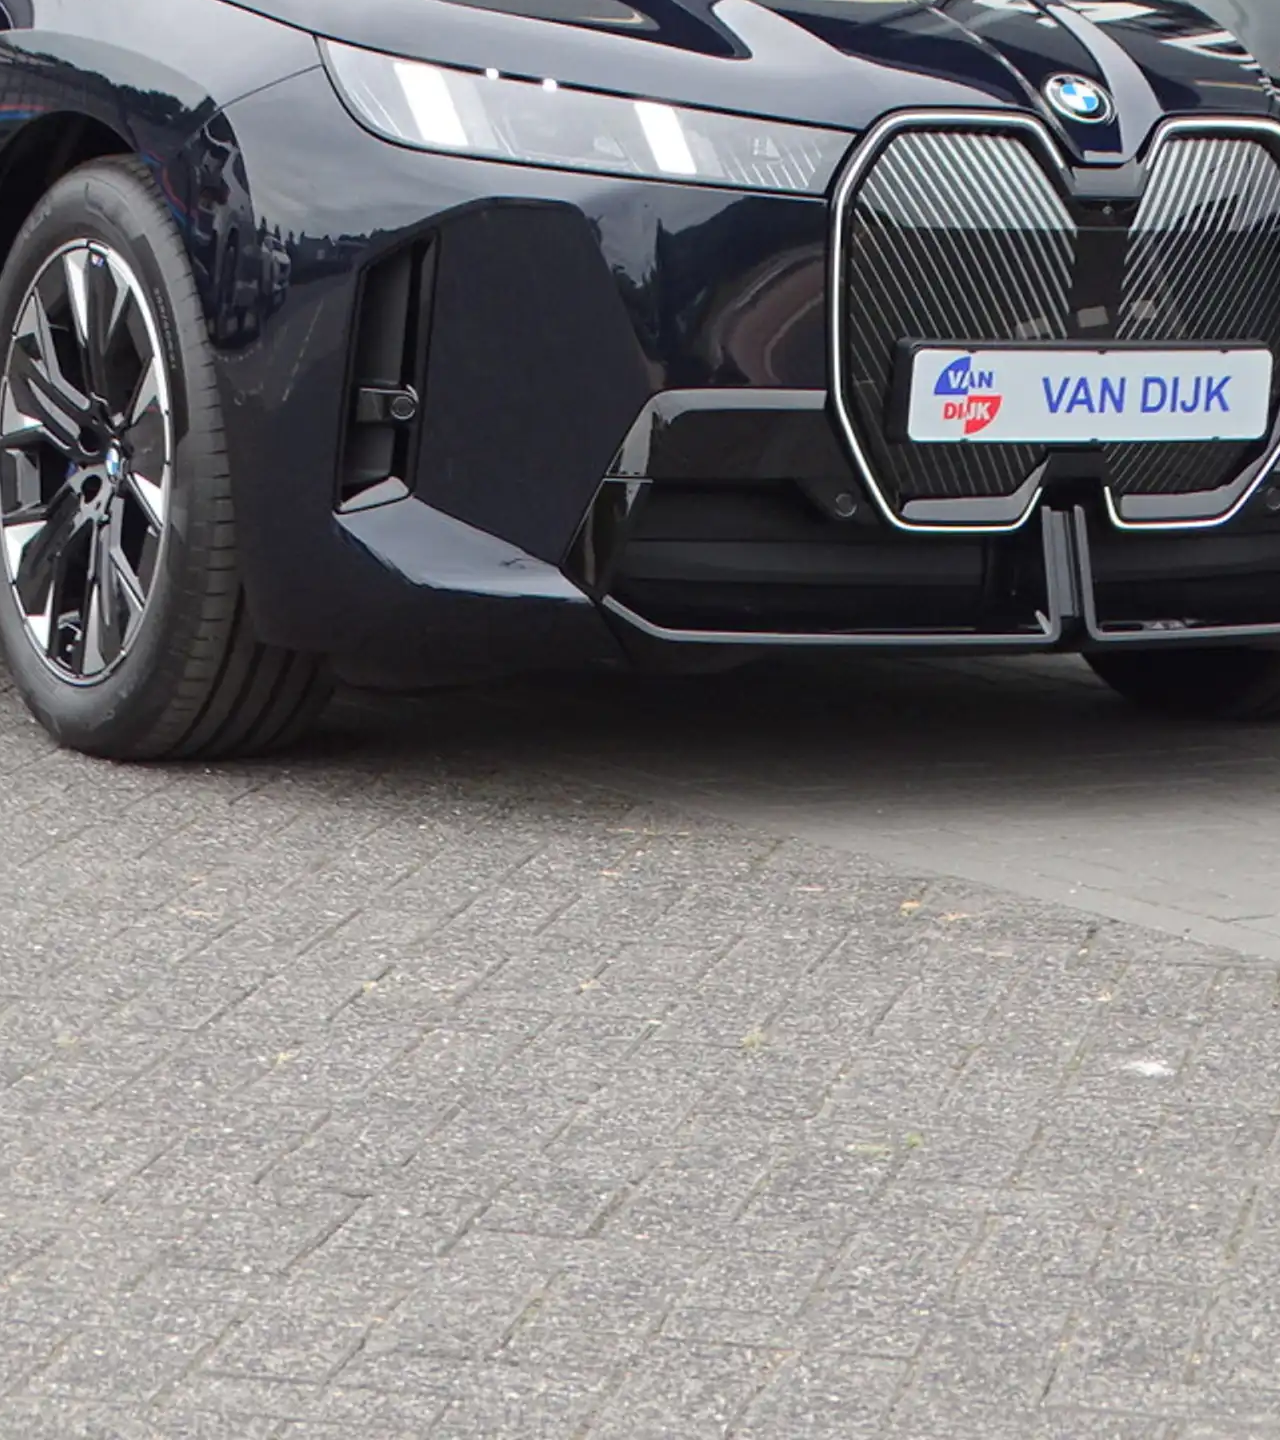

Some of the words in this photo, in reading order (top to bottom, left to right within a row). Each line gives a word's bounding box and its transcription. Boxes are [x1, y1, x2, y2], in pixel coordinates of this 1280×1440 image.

[948, 367, 994, 390] VAN
[1042, 375, 1126, 414] VAN
[1140, 375, 1232, 414] DIJK
[942, 400, 992, 421] DIJK
